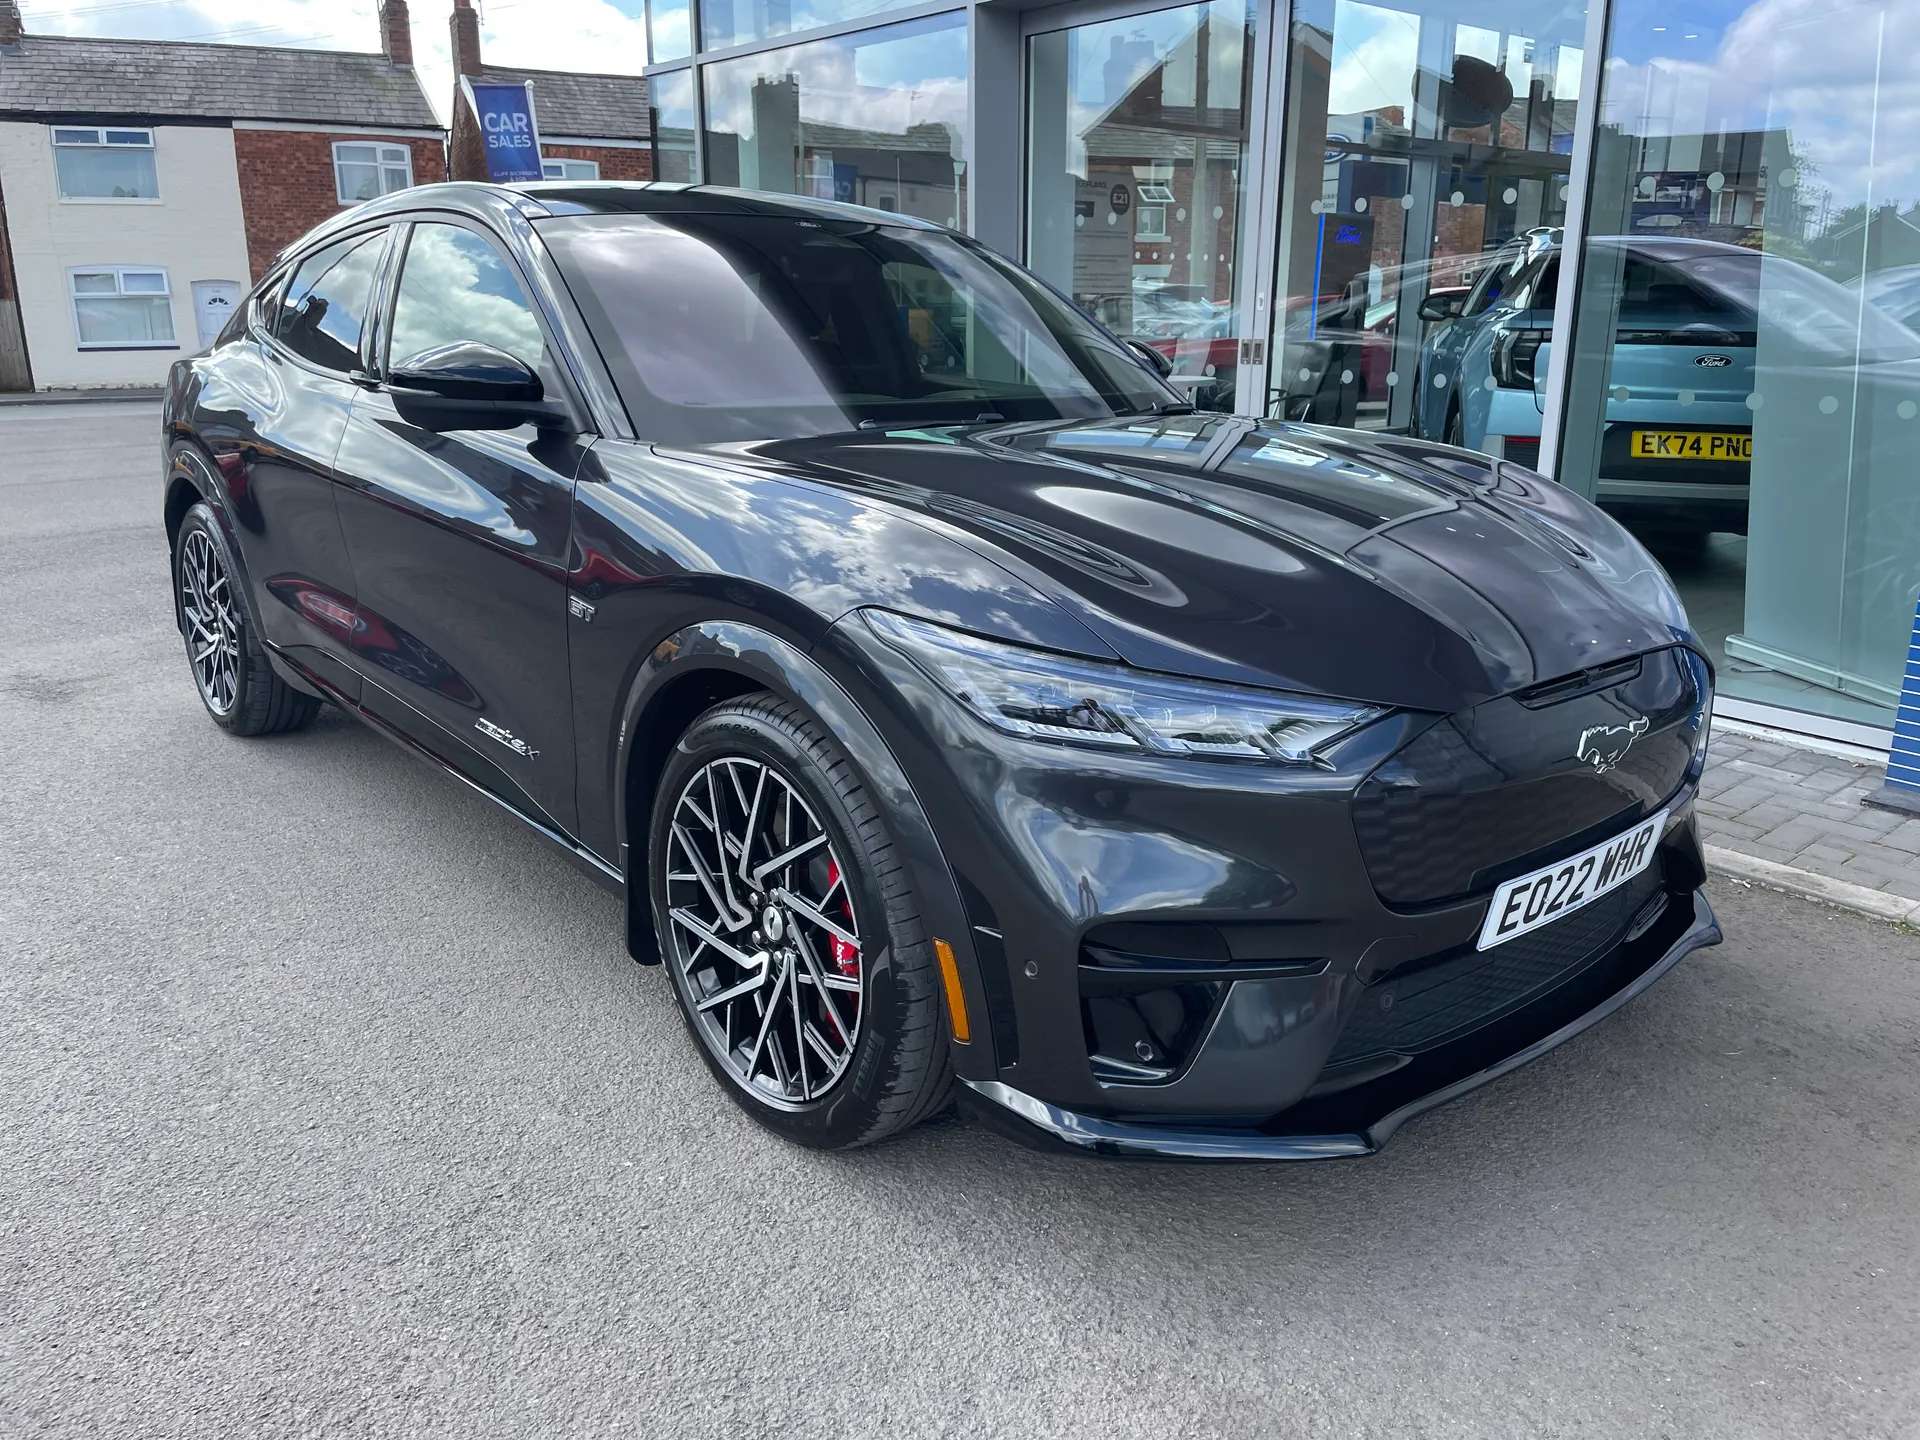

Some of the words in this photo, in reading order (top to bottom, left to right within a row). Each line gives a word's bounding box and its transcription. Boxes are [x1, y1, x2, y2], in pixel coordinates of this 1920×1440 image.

[484, 112, 529, 133] CAR
[488, 135, 532, 149] SALES
[1700, 354, 1728, 367] Ford
[1640, 434, 1703, 456] EK74
[1593, 824, 1655, 892] WHR
